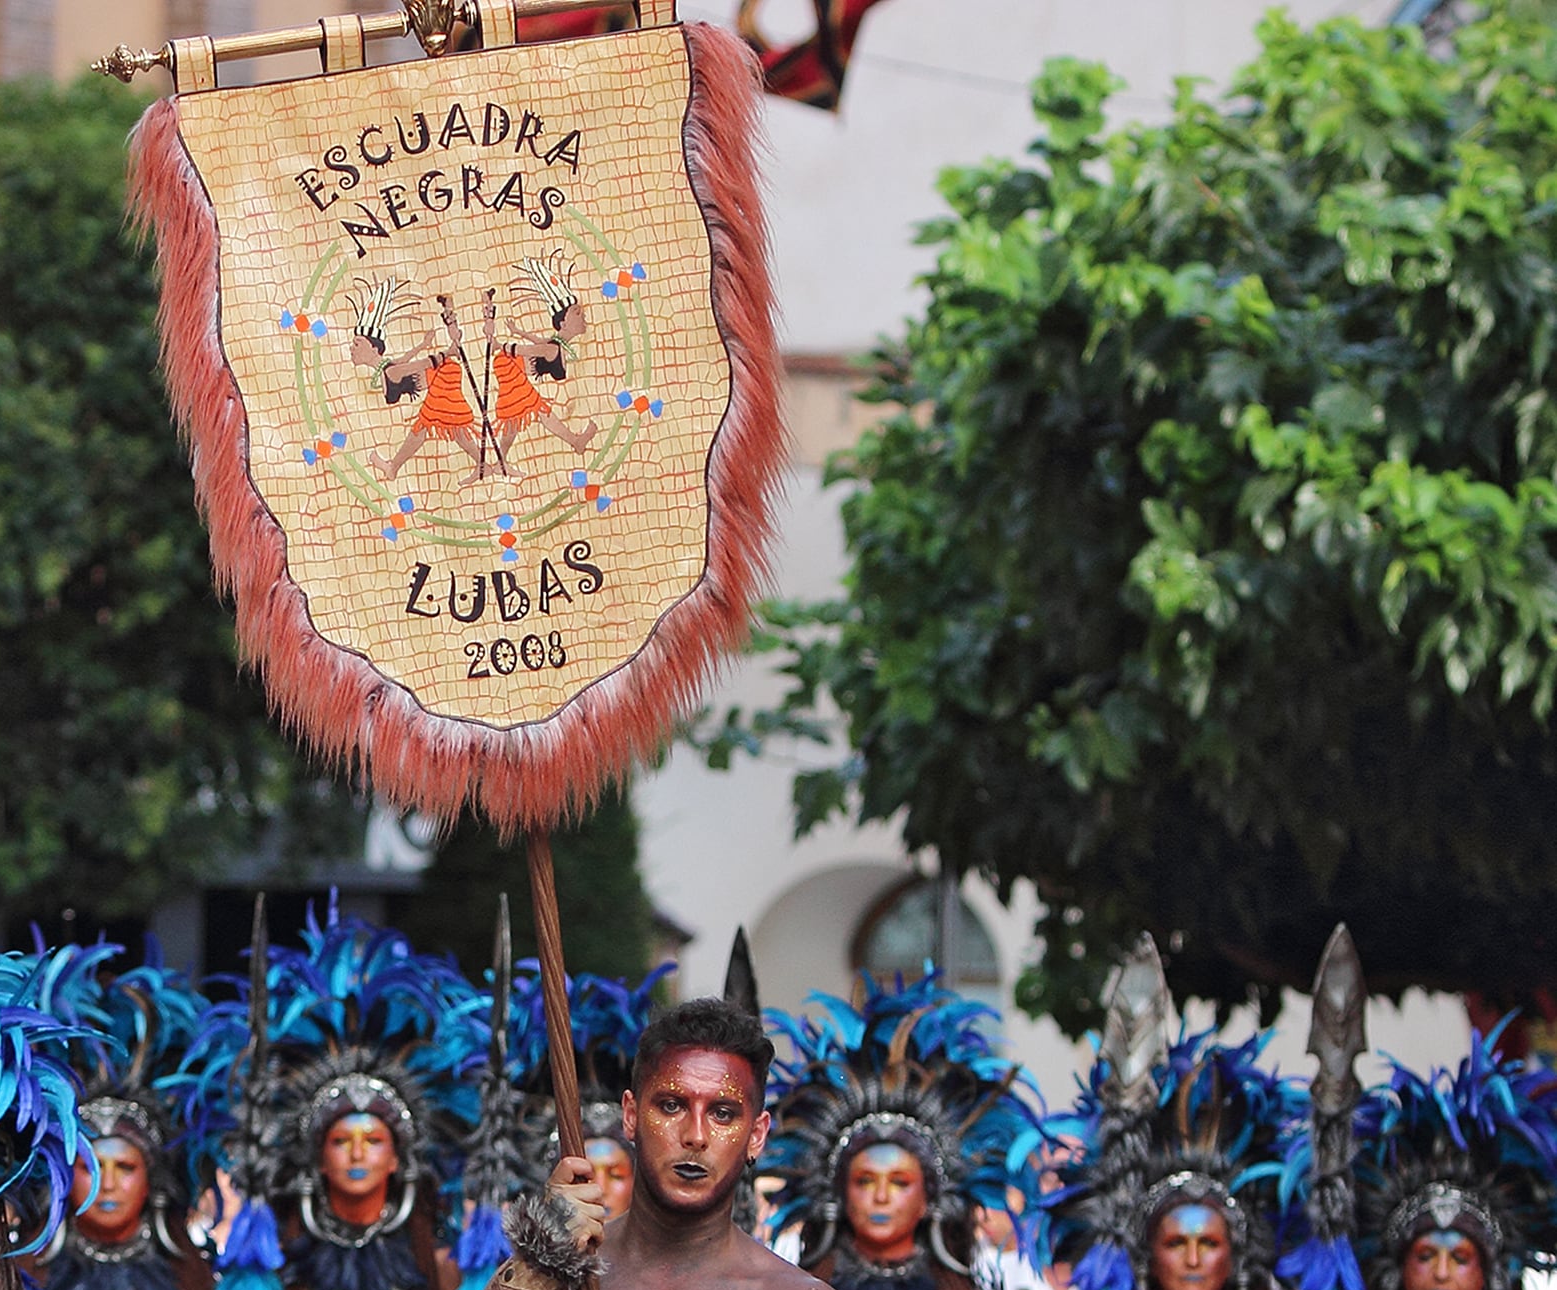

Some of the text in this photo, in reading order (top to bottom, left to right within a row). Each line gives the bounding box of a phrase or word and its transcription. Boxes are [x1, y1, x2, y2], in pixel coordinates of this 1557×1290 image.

[294, 101, 584, 213] ESCUADRA
[339, 164, 566, 260] NEGRAS
[404, 540, 604, 624] LUBAS
[463, 630, 568, 680] 2008
